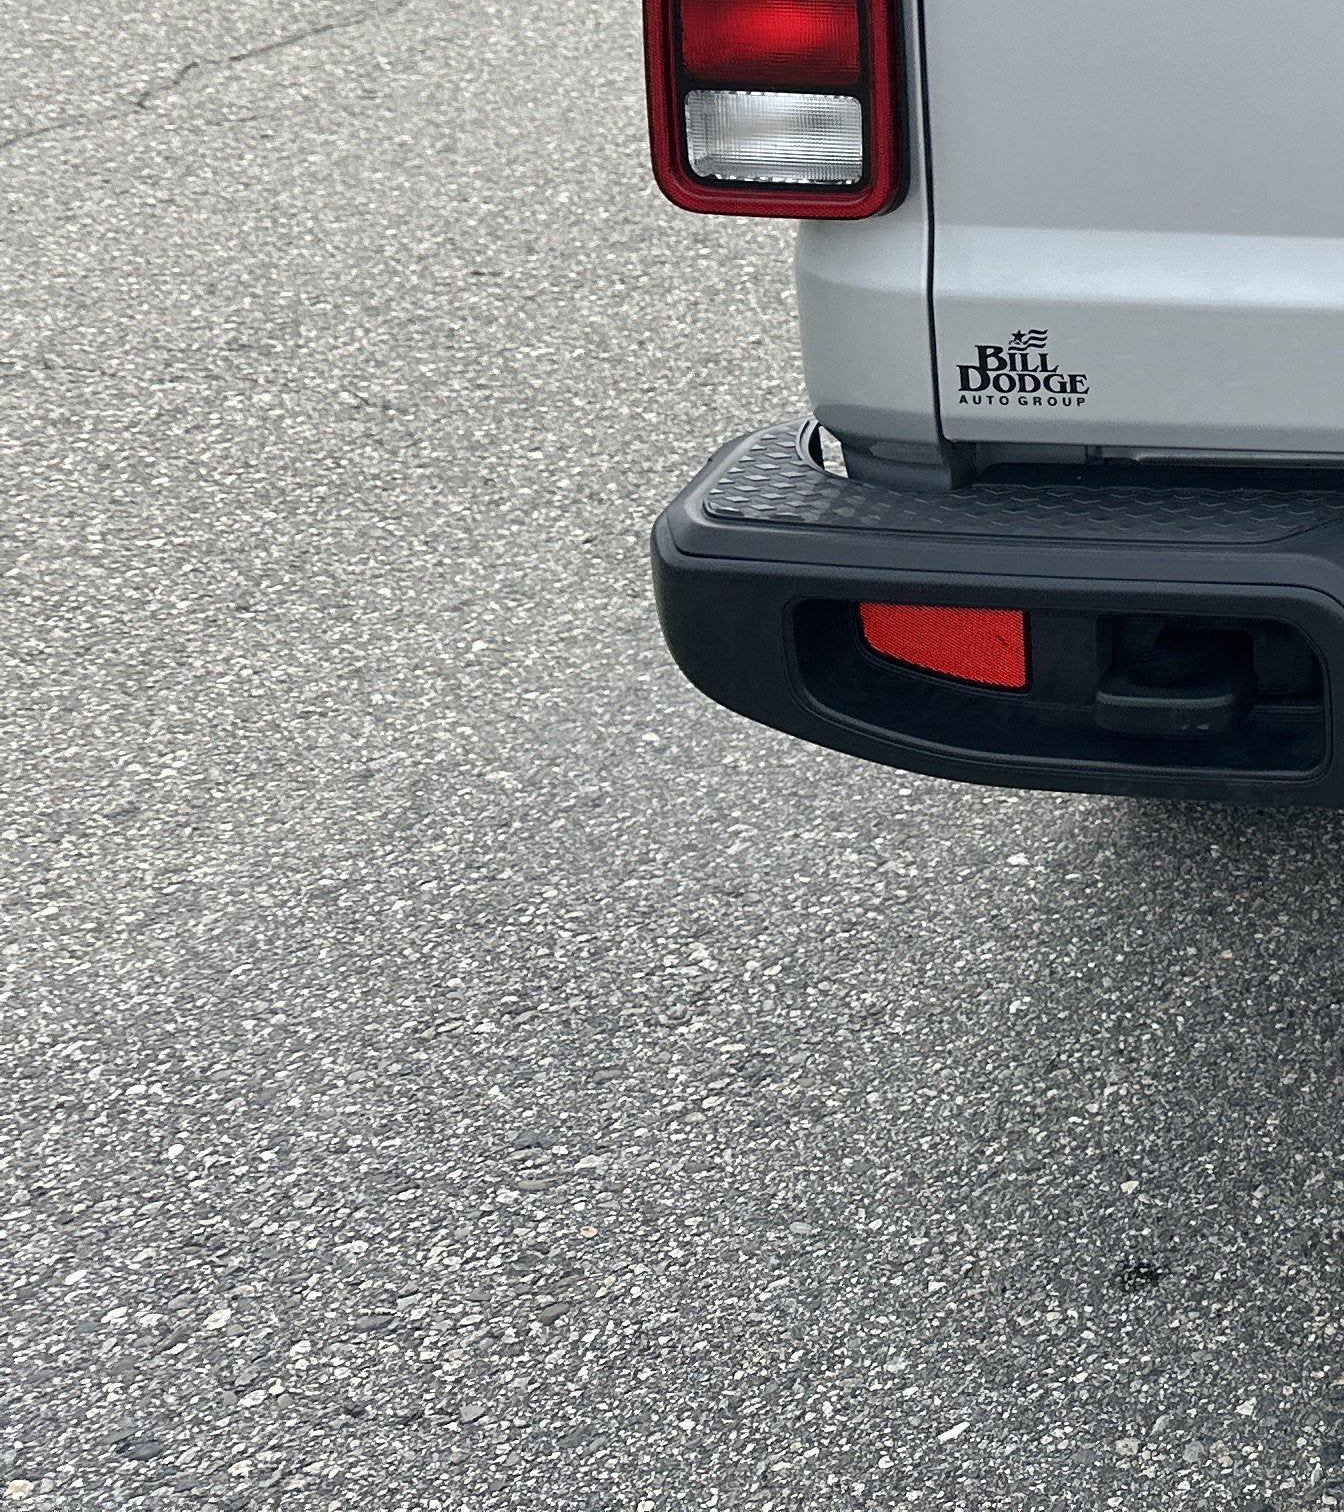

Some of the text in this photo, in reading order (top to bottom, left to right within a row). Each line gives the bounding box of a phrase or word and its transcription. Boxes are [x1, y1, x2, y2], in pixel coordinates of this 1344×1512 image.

[975, 344, 1059, 373] BILL
[956, 364, 1090, 395] DODGE
[958, 394, 1087, 407] AUTO GROUP
